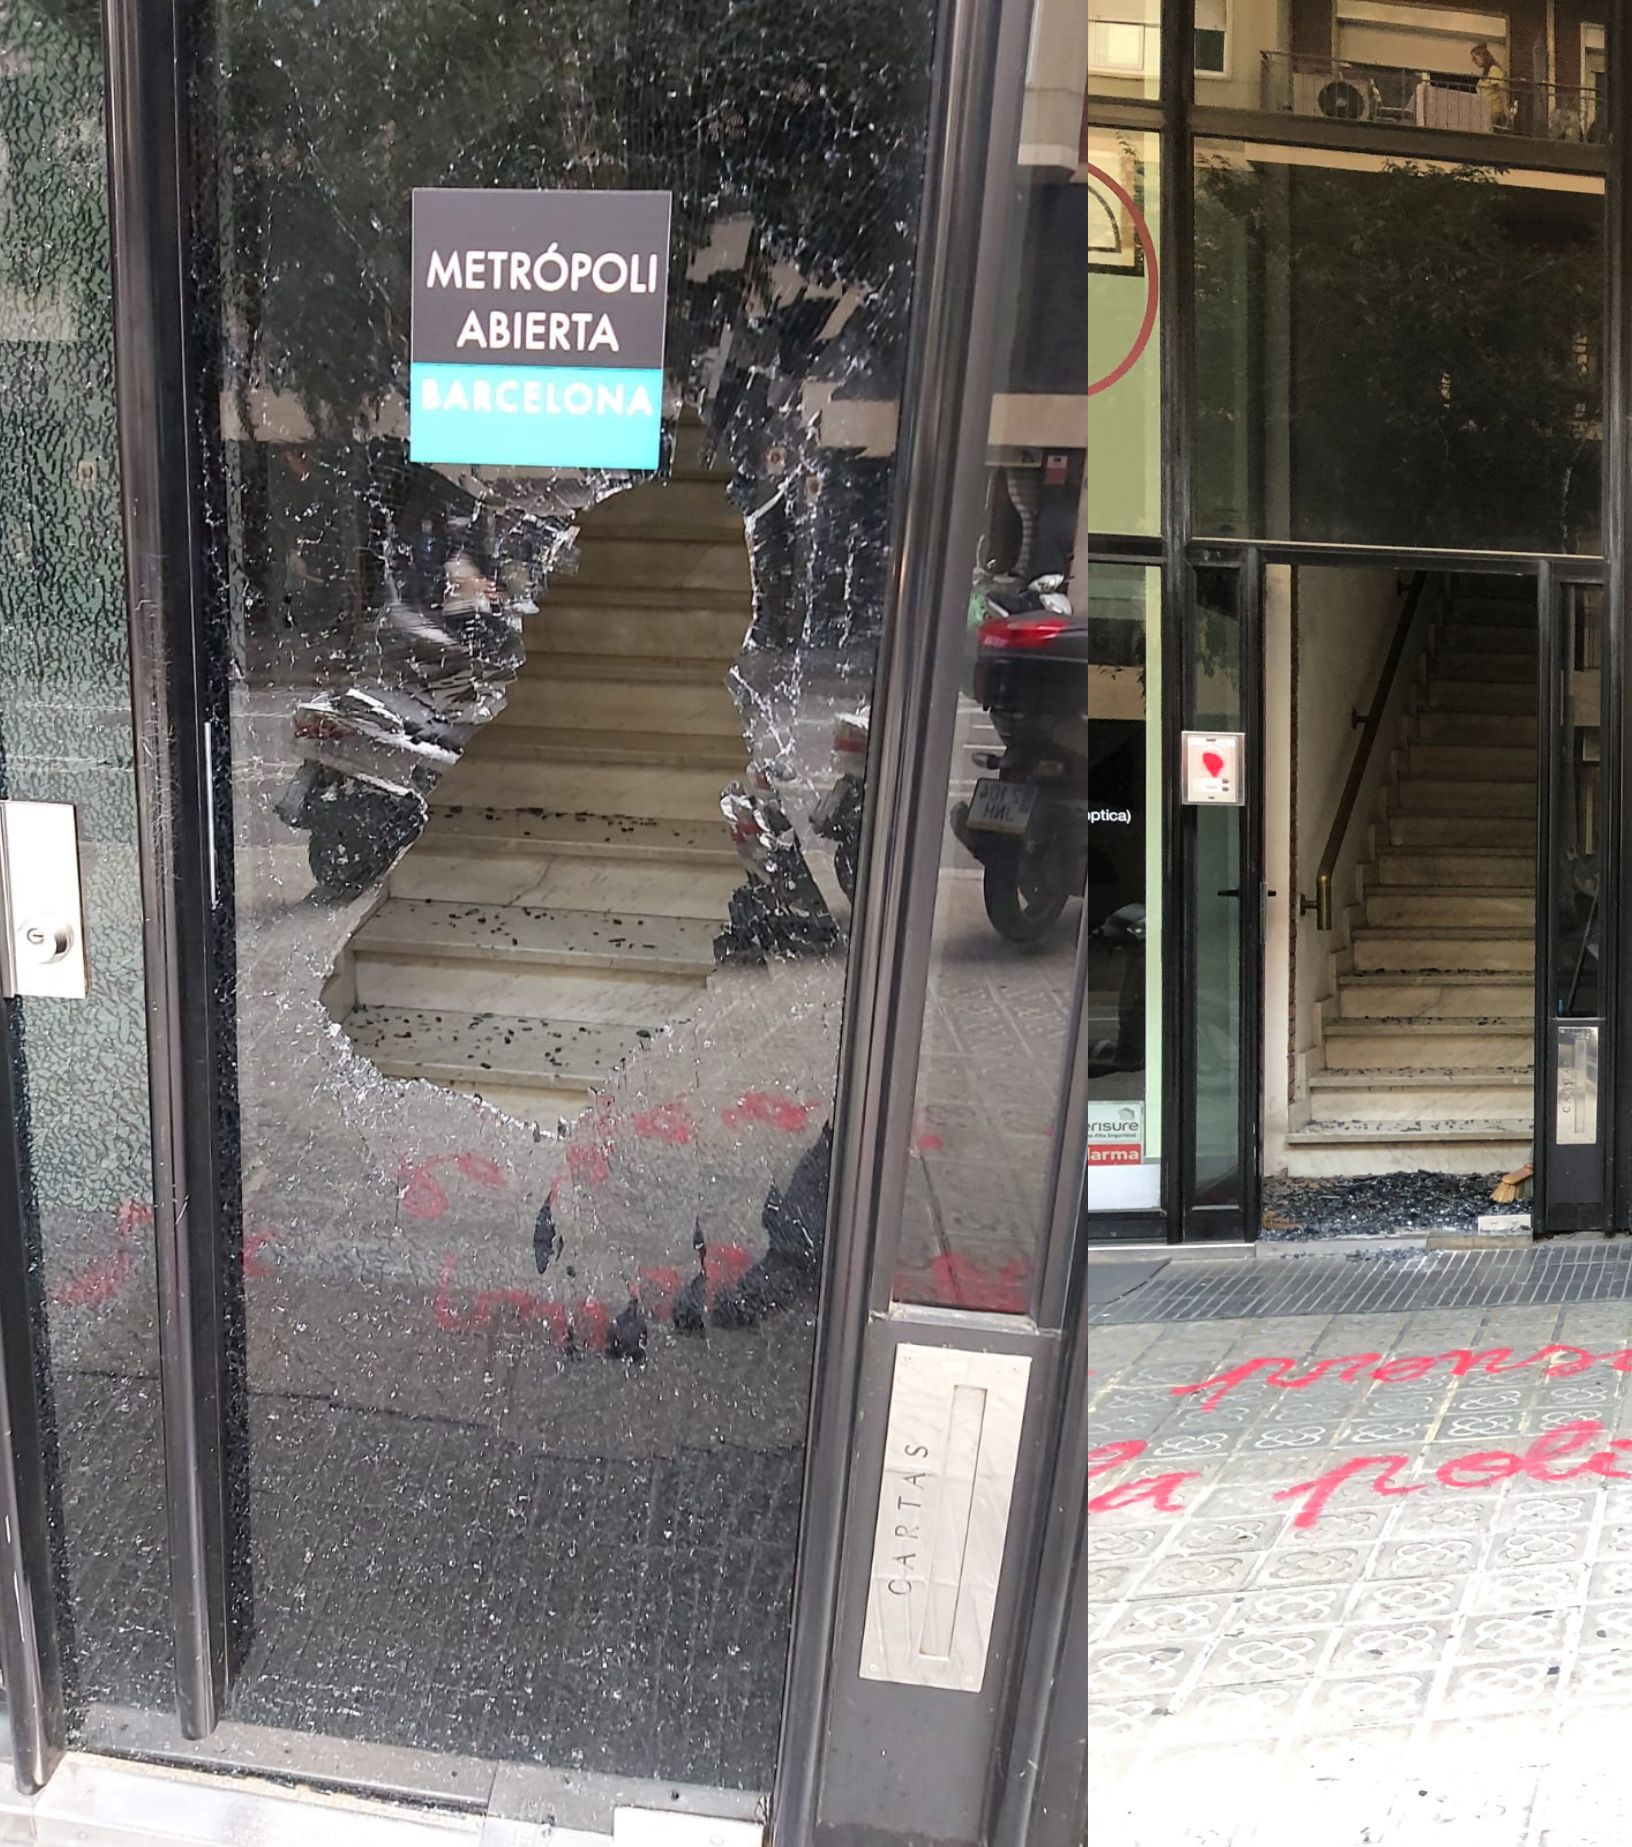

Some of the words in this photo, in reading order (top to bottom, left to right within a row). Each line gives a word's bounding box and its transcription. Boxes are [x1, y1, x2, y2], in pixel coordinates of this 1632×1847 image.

[426, 242, 657, 294] METRÓPOLI
[456, 310, 619, 352] ABIERTA
[420, 378, 653, 416] BARCELONA
[888, 1444, 929, 1596] CARTAS
